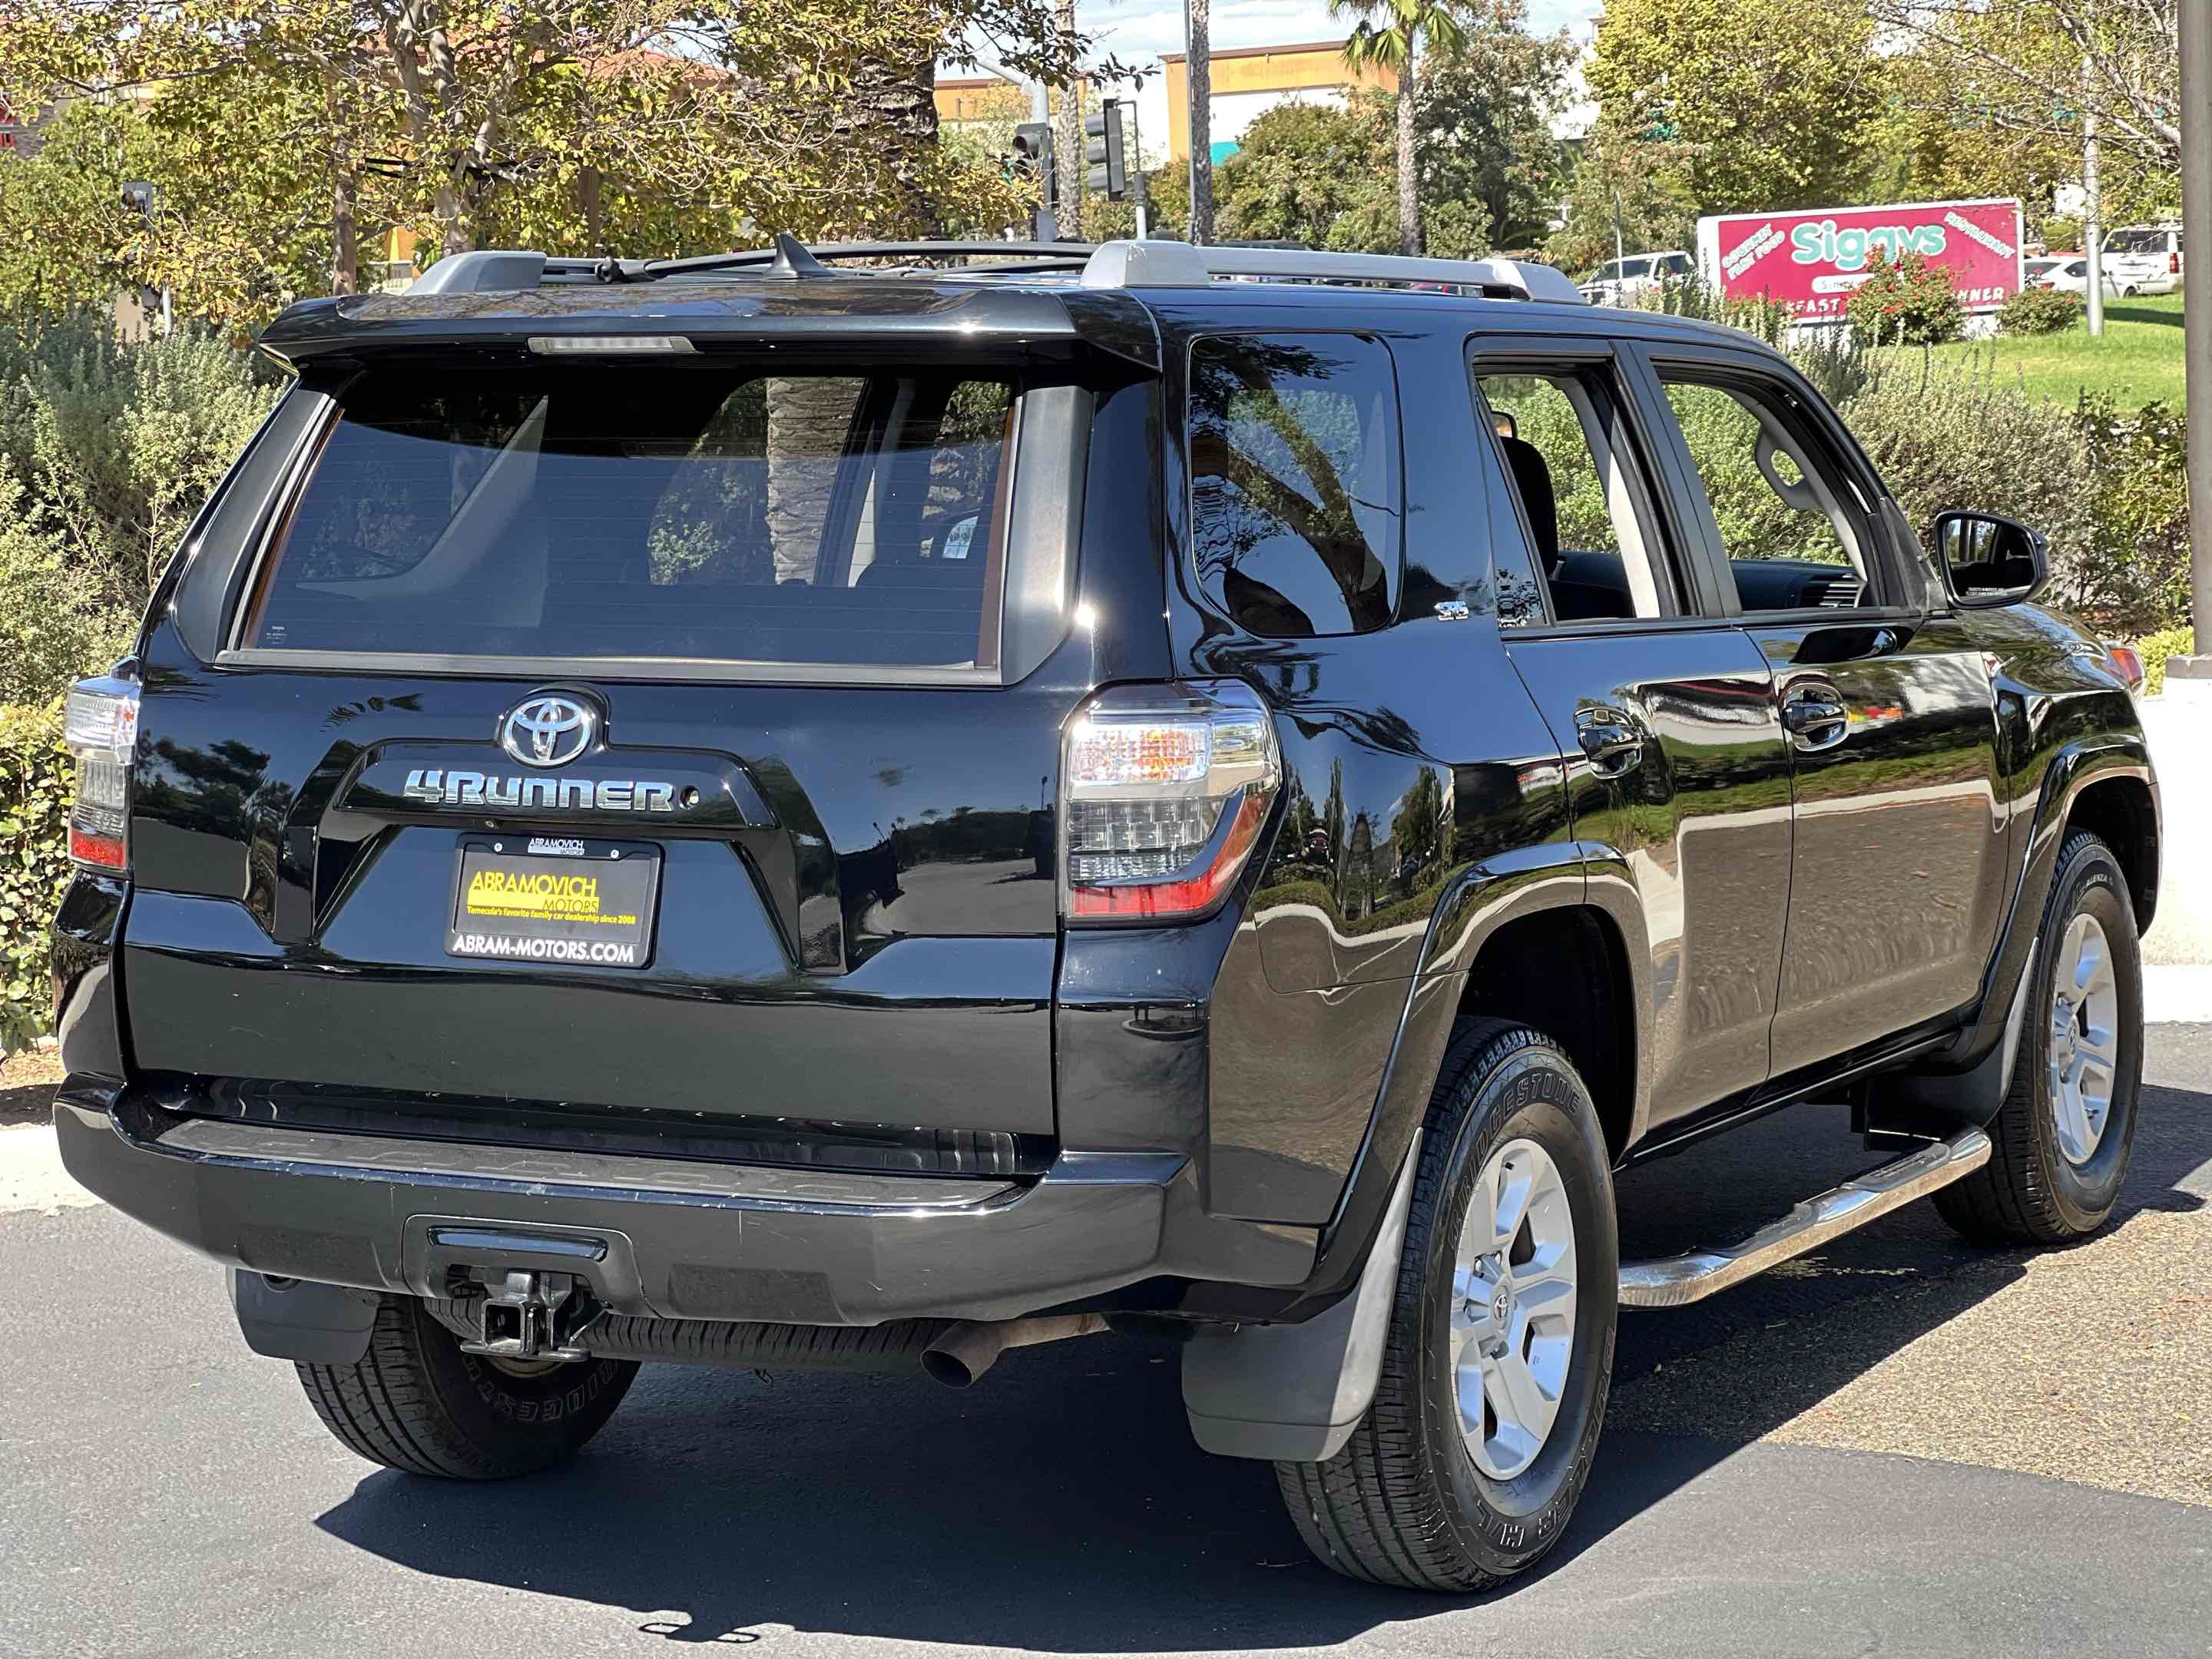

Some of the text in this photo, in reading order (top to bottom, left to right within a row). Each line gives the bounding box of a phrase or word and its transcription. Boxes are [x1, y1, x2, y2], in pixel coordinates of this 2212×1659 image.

[1722, 223, 1773, 268] GOURMET
[1727, 230, 1786, 280] FAST FOOD
[1785, 286, 2005, 313] KFAST NNER
[528, 837, 584, 850] ABRAMOVICH
[471, 871, 597, 897] ABRAMOVICH
[467, 906, 503, 917] Temecula's
[503, 908, 530, 919] favorite
[530, 909, 553, 921] family
[565, 912, 600, 925] dealership
[599, 914, 618, 923] since
[542, 897, 599, 912] MOTORS
[453, 934, 634, 963] ABRAM-MOTORS.COM
